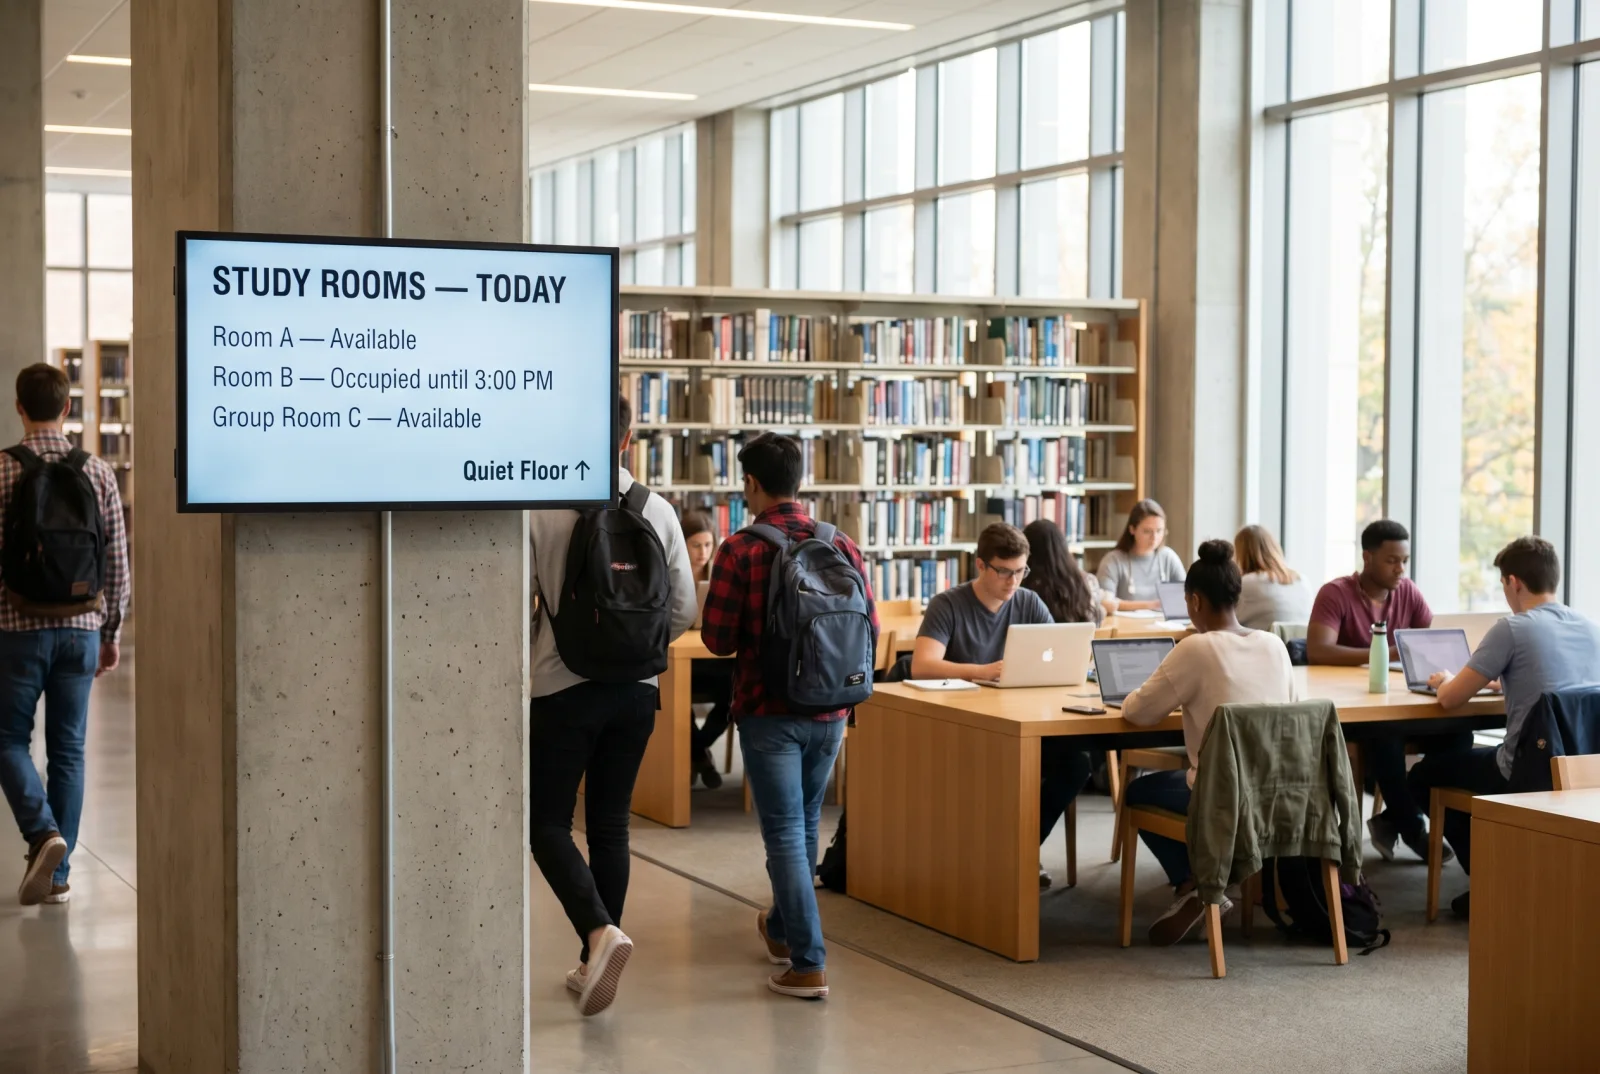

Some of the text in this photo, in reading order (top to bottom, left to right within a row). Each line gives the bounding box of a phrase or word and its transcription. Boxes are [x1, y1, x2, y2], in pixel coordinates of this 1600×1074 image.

[213, 265, 311, 297] STUDY
[322, 269, 425, 300] ROOMS
[476, 274, 566, 303] TODAY
[213, 326, 272, 347] Room
[280, 327, 294, 347] A
[330, 328, 416, 350] Available
[213, 366, 272, 387] Room
[281, 367, 293, 387] B
[331, 367, 420, 393] Occupied
[428, 369, 468, 390] until
[475, 370, 516, 390] 3:00
[524, 370, 553, 390] PM
[213, 406, 274, 432] Group
[283, 407, 340, 427] Room
[348, 407, 361, 428] C
[397, 408, 481, 428] Available
[464, 460, 568, 482] Quiet Floor
